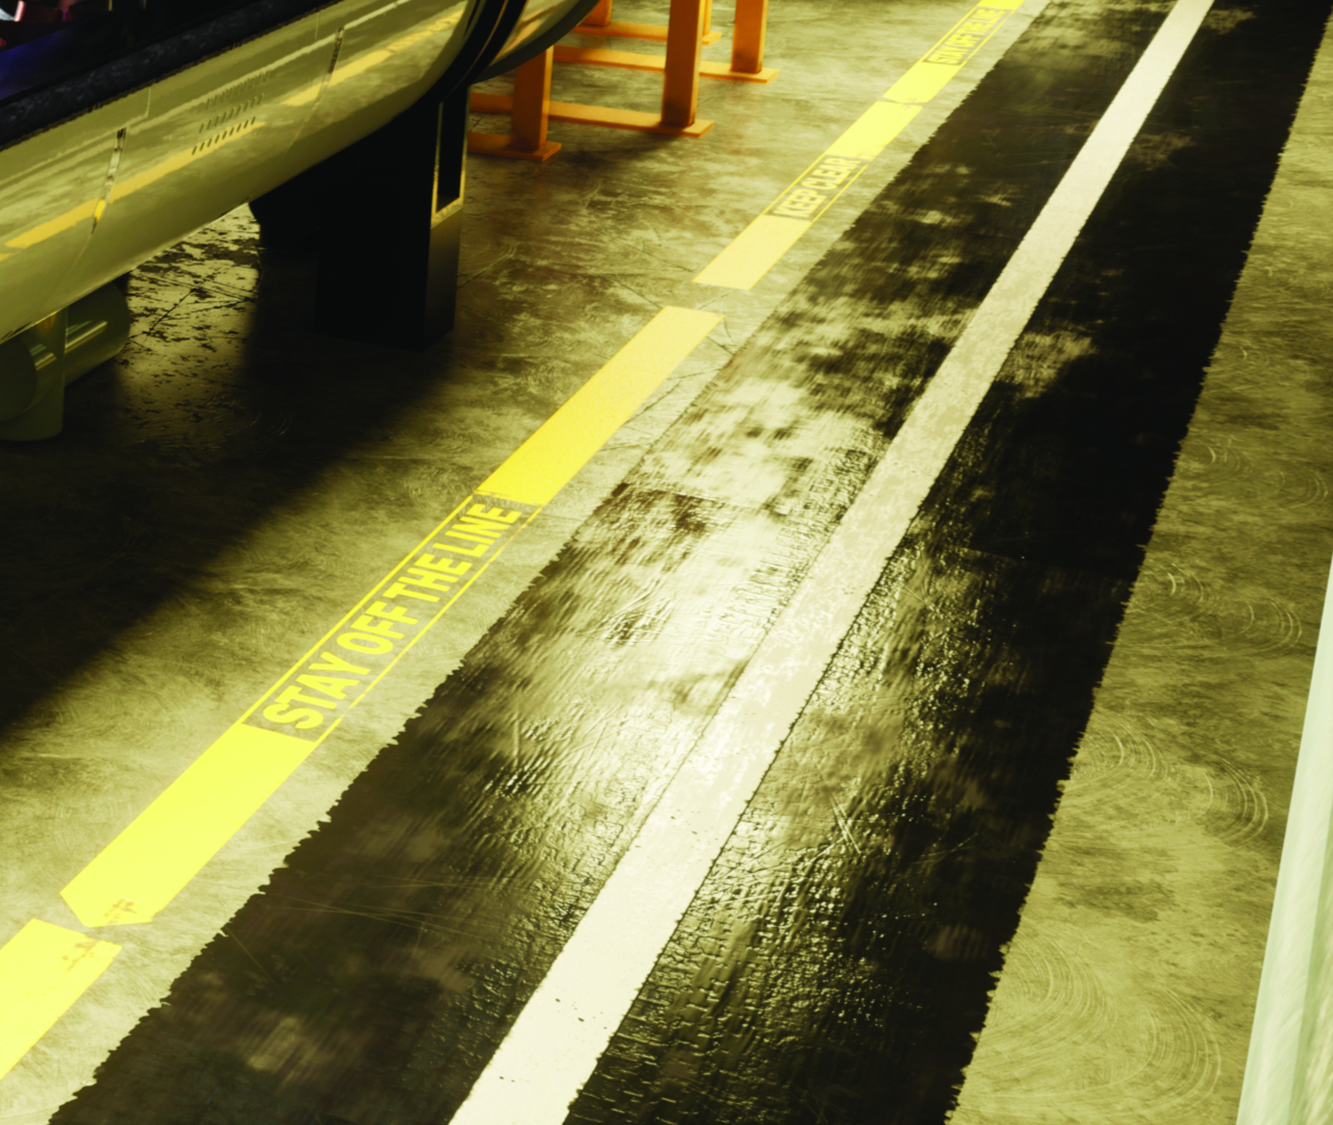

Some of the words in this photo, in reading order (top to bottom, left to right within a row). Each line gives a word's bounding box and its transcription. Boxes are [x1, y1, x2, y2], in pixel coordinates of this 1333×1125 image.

[773, 188, 828, 218] KEEP
[801, 157, 862, 191] CLEAR
[262, 651, 371, 730] STAY
[336, 600, 419, 655] OFF
[382, 553, 473, 603] THE
[432, 503, 522, 558] LINE
